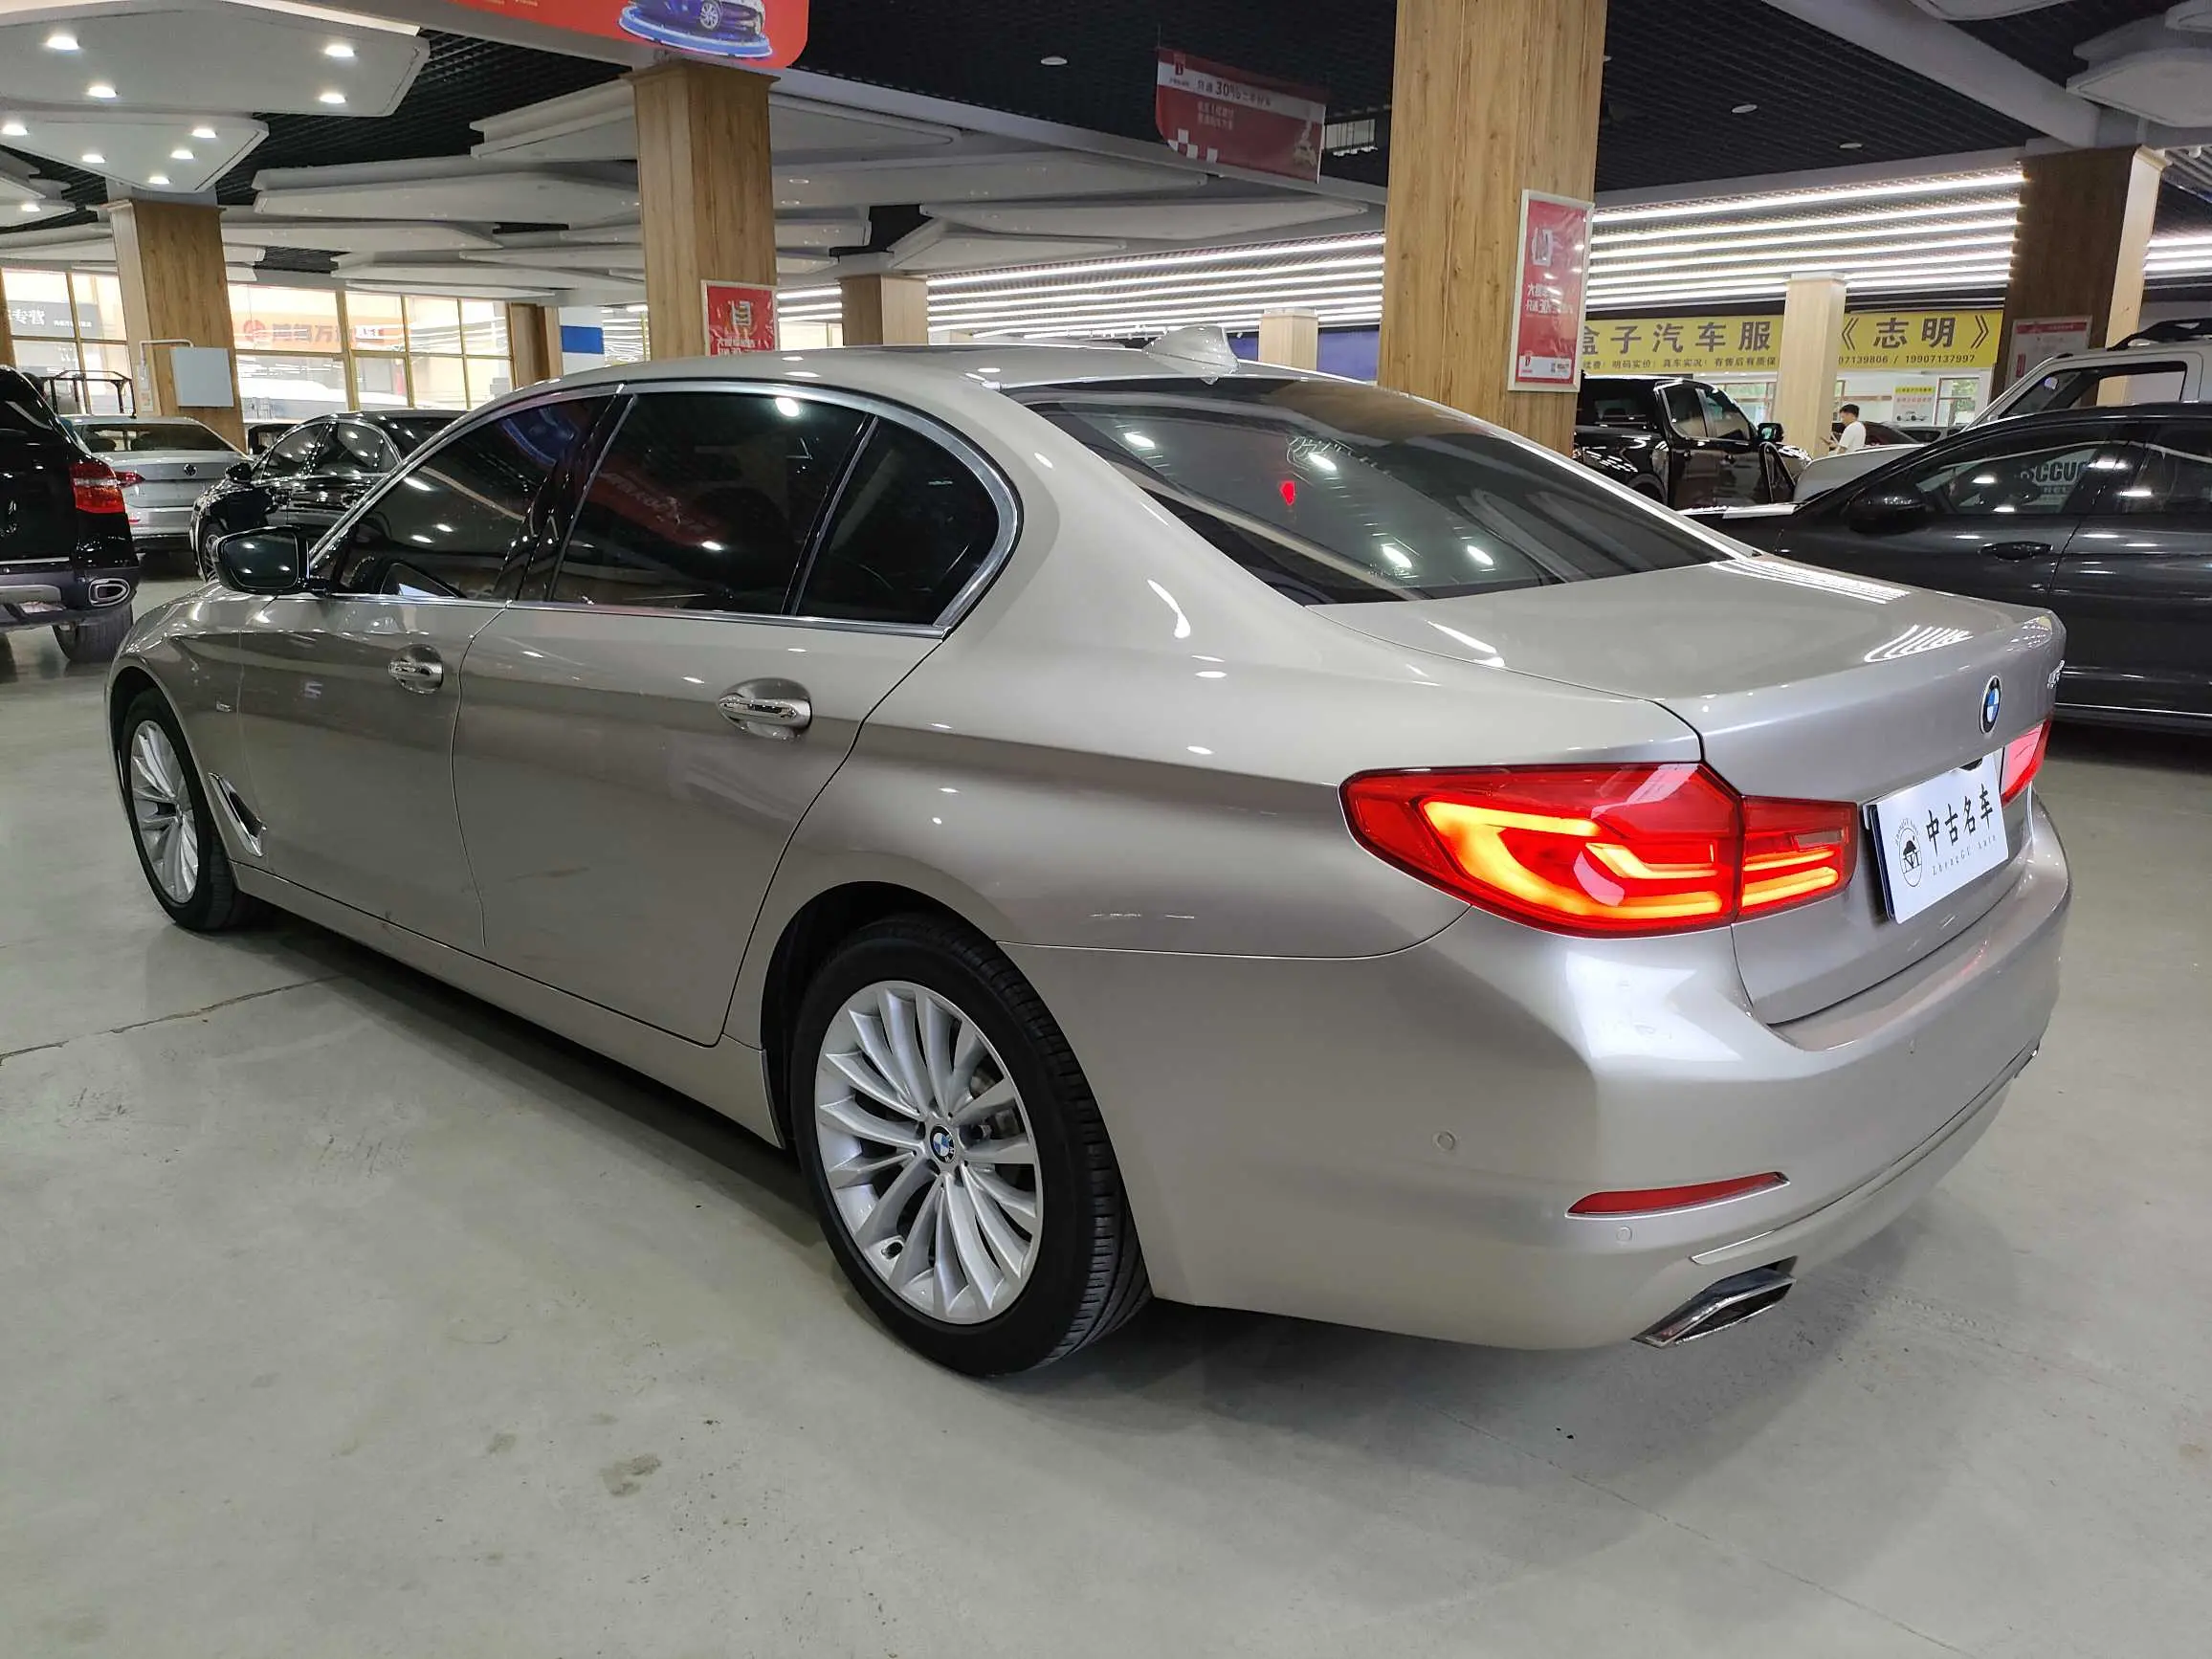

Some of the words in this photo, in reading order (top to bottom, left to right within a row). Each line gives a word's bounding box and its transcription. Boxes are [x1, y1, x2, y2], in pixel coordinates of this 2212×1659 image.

[1582, 321, 1771, 355] 盒子汽车服
[1926, 783, 1993, 857] 中古名车
